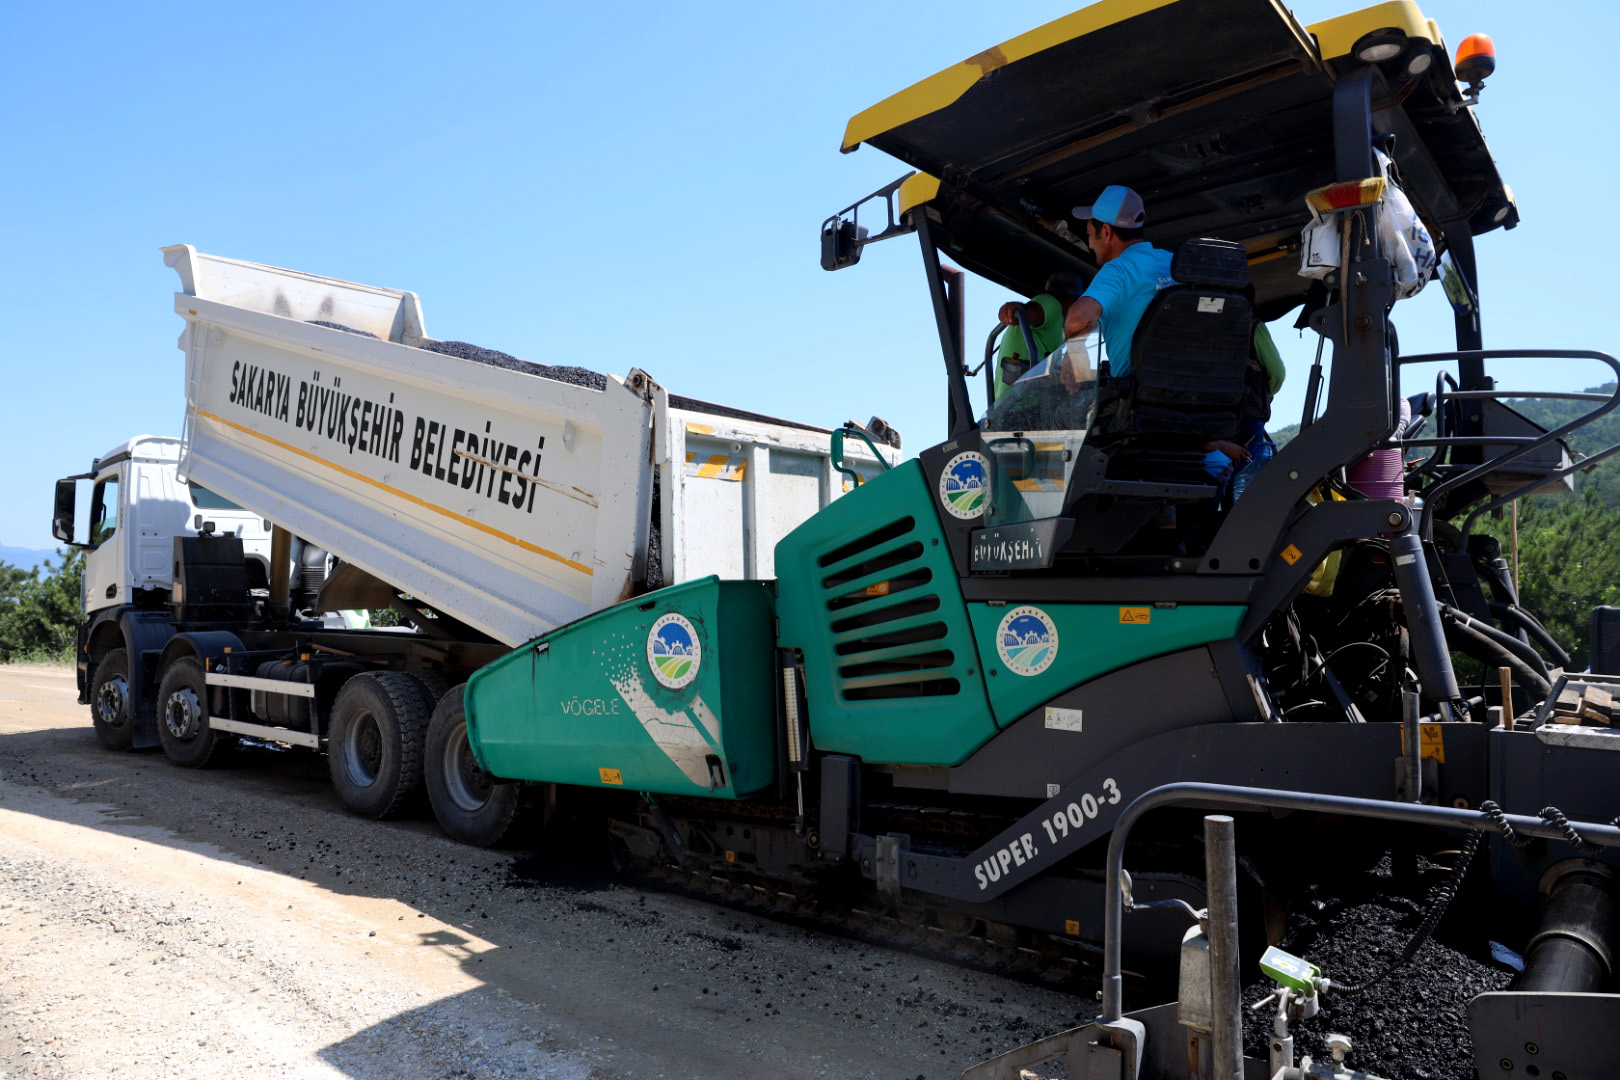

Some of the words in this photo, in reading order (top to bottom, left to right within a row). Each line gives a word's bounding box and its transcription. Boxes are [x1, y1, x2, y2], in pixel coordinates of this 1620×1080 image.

[229, 360, 291, 423] SAKARYA
[295, 370, 404, 464] BÜYÜKŞEHİR
[409, 416, 545, 514] BELEDİYESİ
[560, 696, 620, 716] VÖGELE
[1041, 777, 1122, 845] 1900-3
